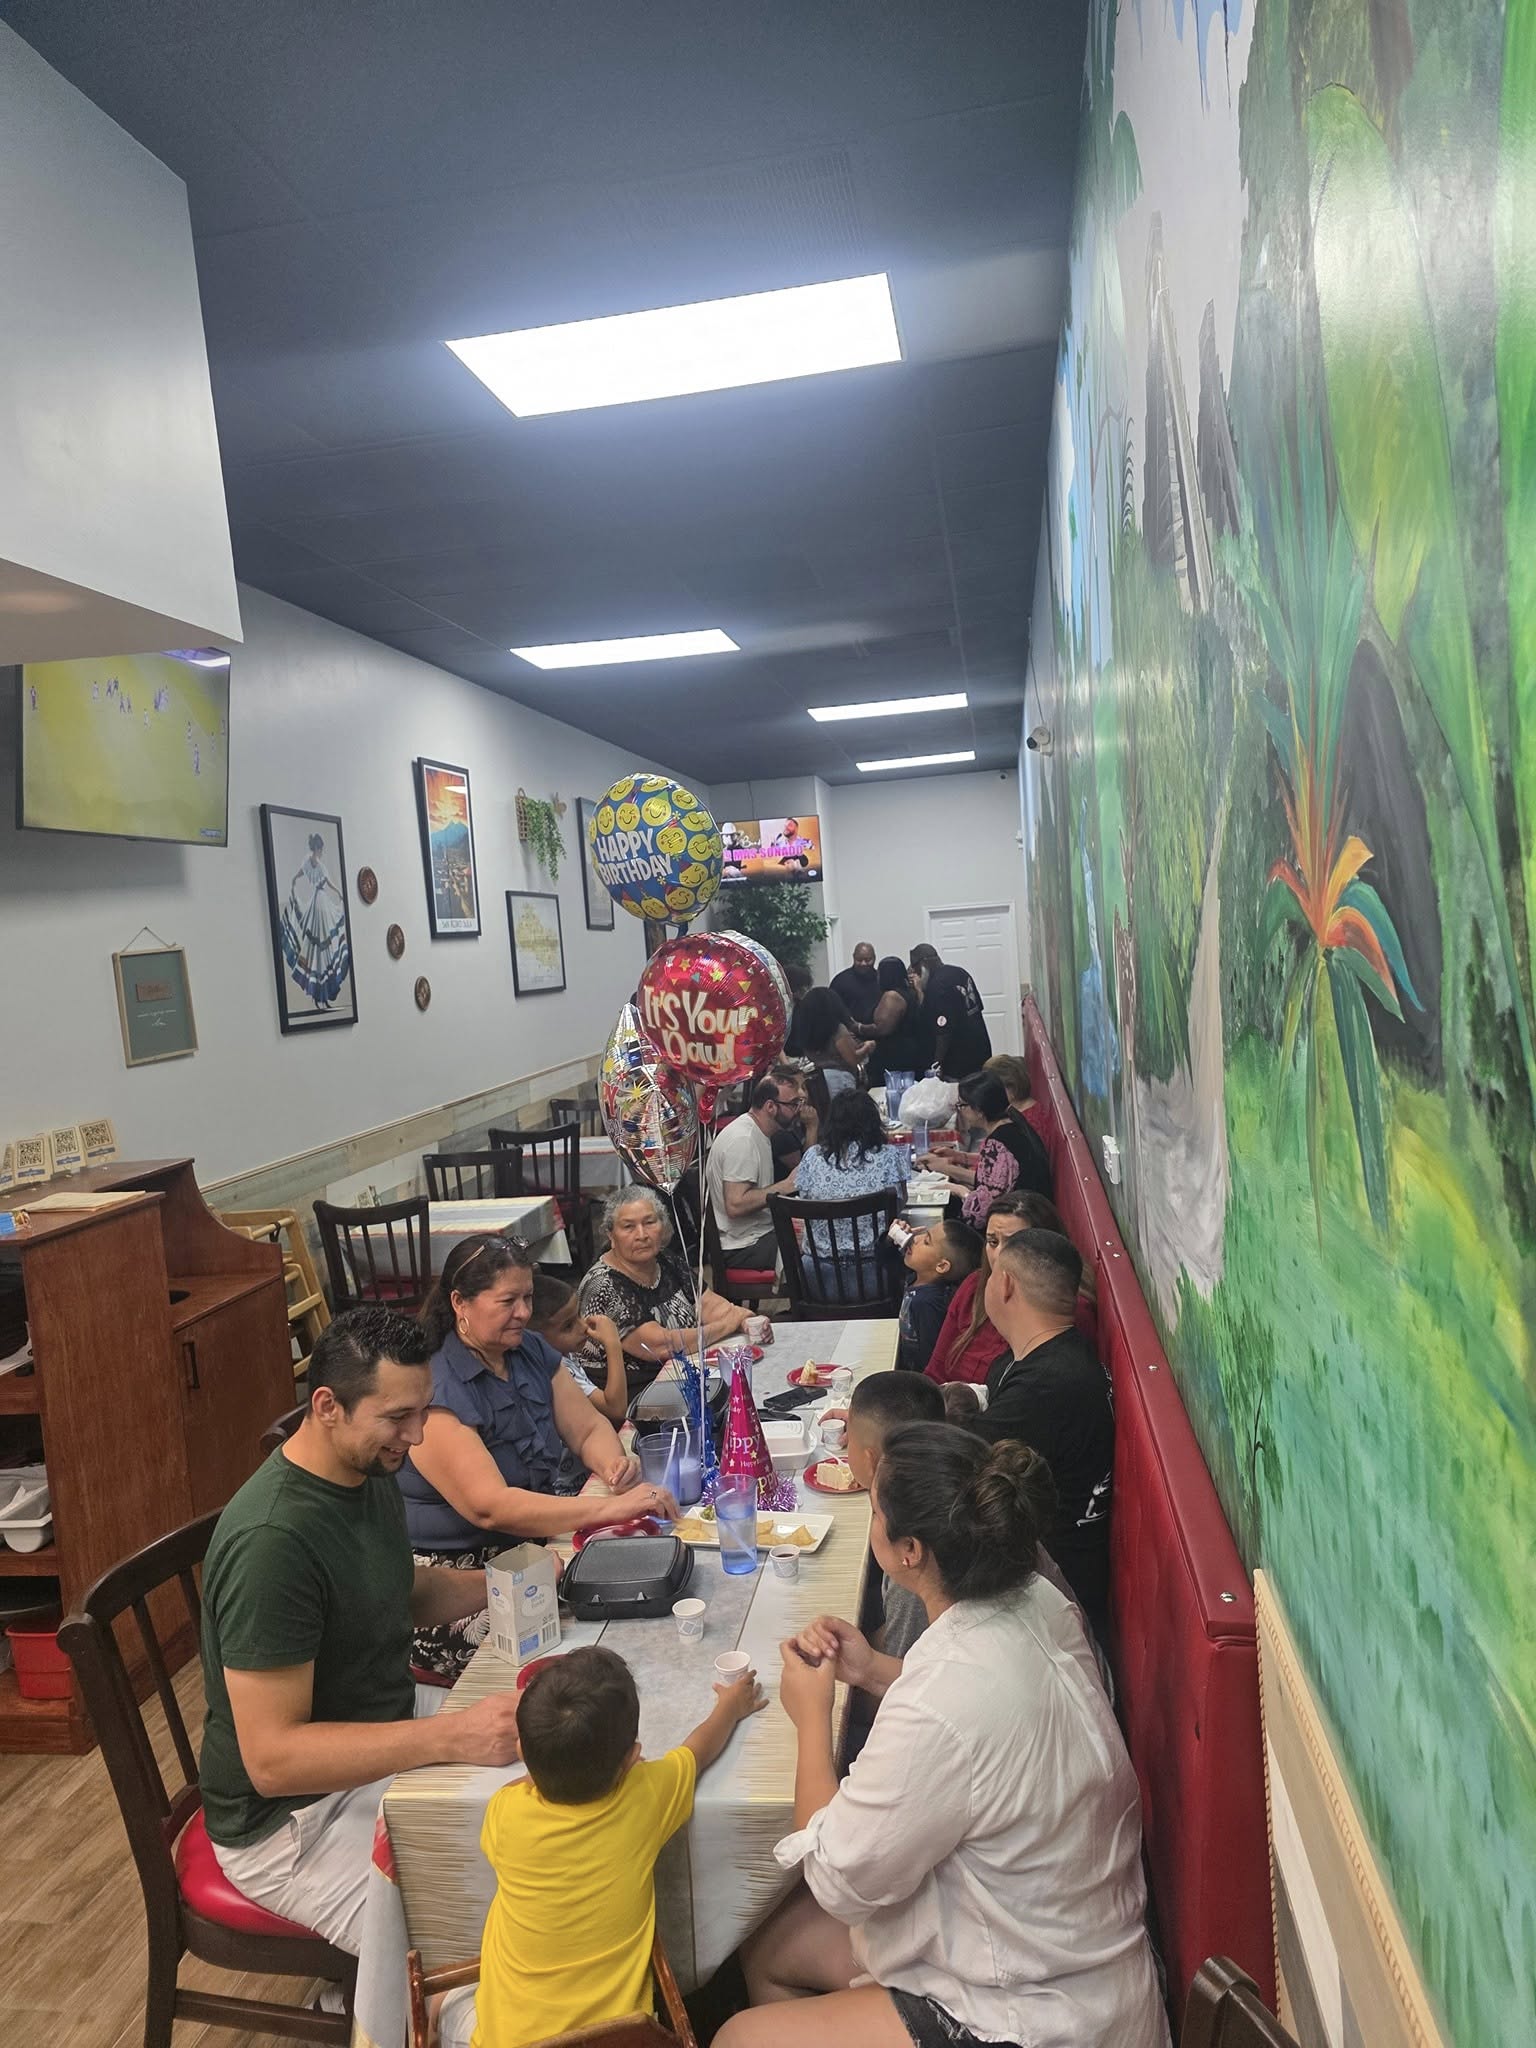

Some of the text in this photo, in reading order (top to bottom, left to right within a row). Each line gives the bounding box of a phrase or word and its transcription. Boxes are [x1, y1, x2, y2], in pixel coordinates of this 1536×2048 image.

[597, 828, 654, 862] HAPPY
[600, 853, 673, 886] BIRTHDAY
[682, 989, 759, 1036] Your
[661, 1028, 737, 1074] Day!
